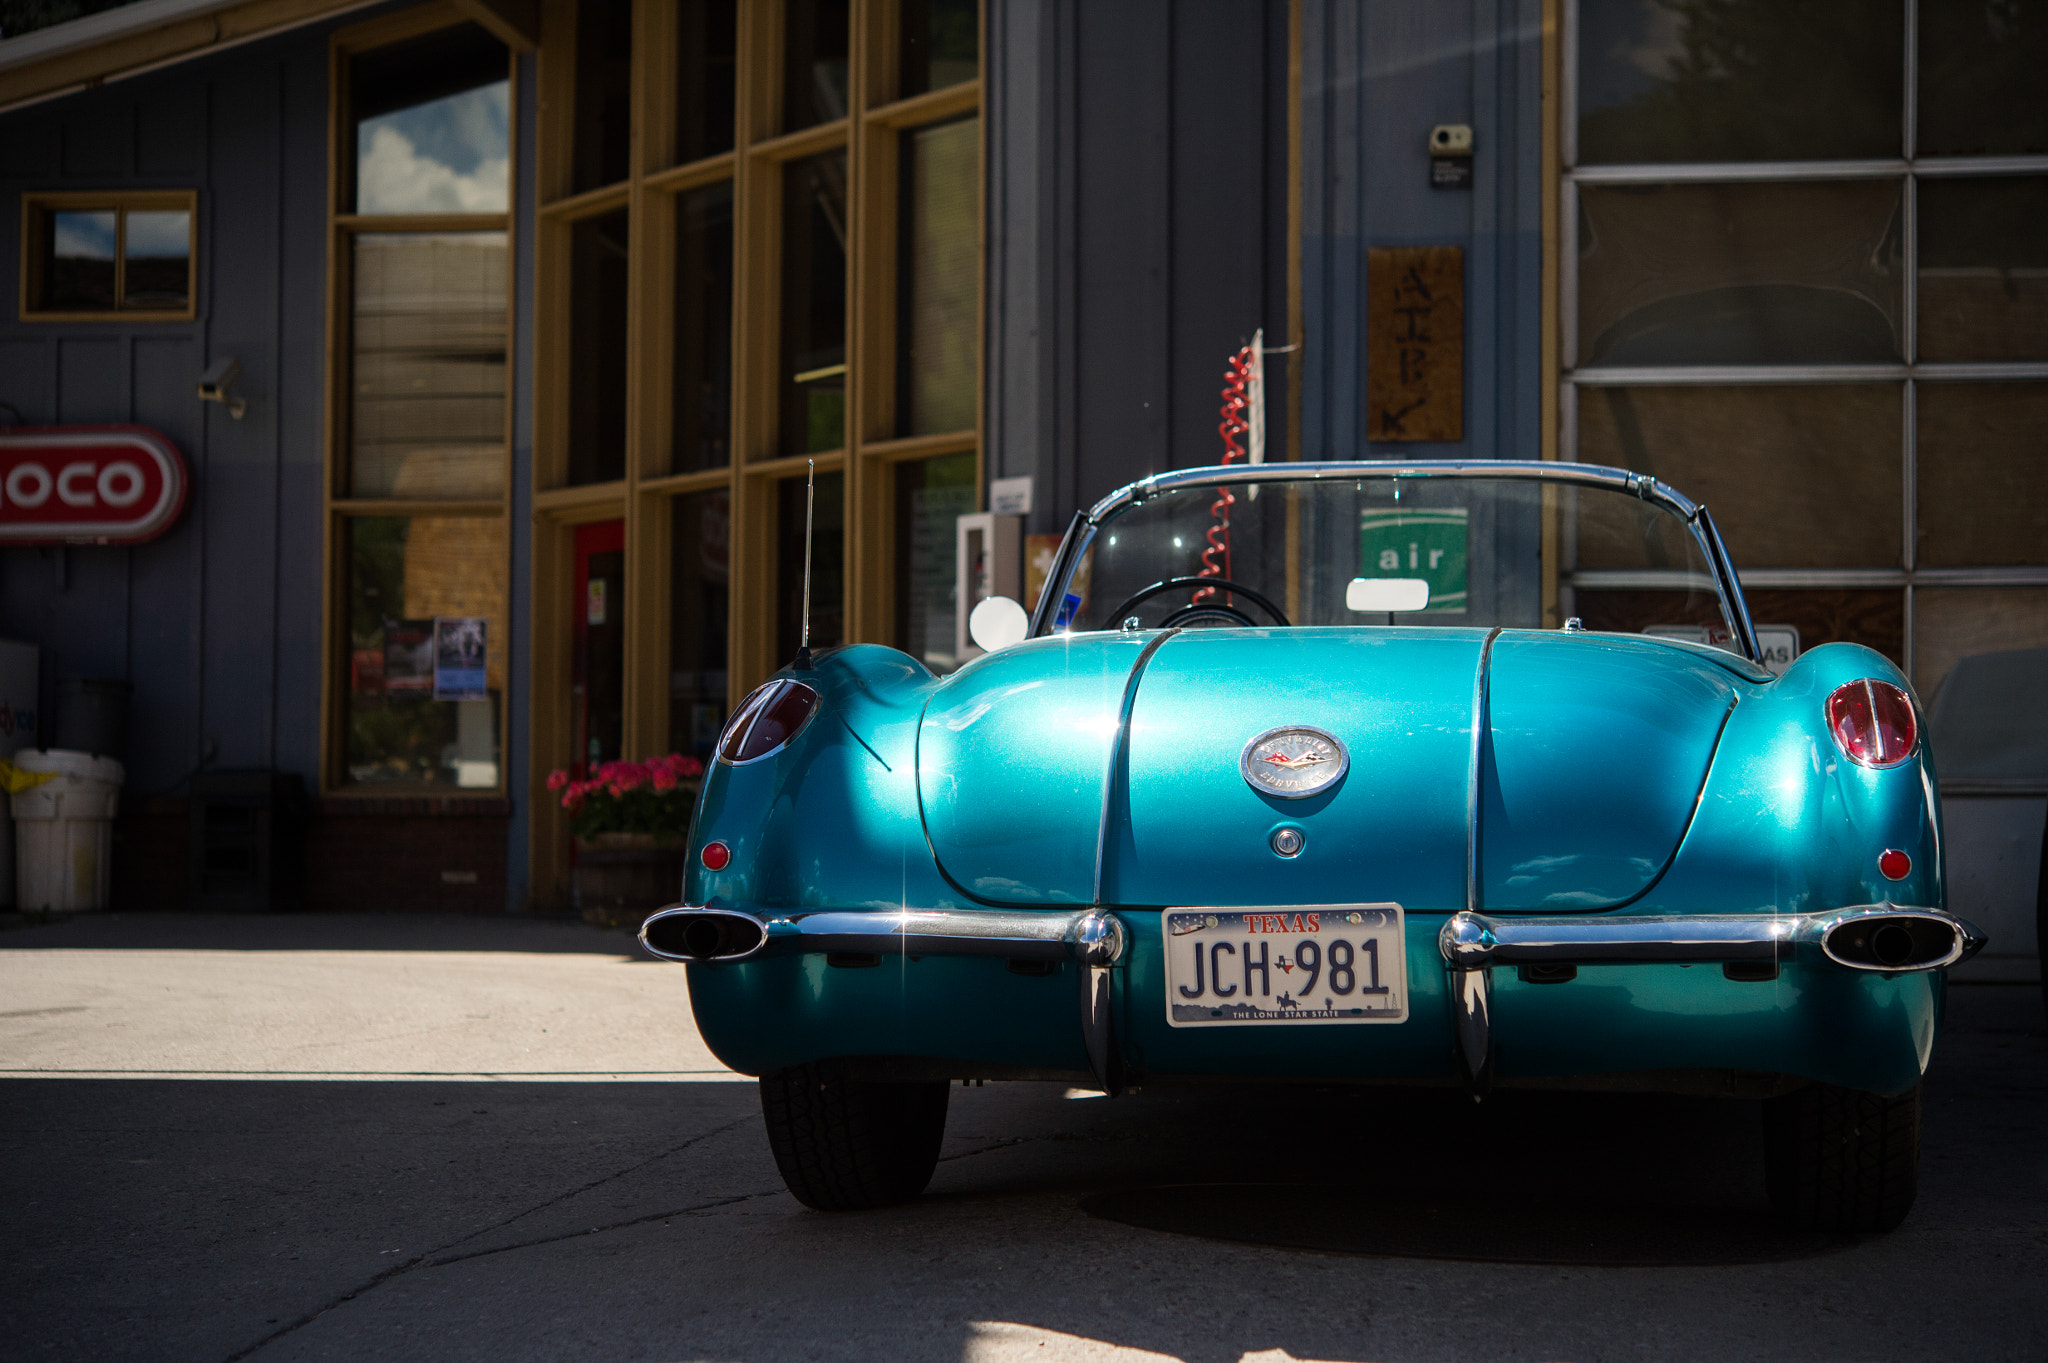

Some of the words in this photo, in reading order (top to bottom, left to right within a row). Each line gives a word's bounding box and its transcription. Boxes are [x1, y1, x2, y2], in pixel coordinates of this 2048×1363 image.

[1379, 542, 1444, 570] air
[1243, 914, 1320, 934] TEXAS
[1179, 941, 1270, 998] JCH
[1295, 938, 1389, 997] 981
[1254, 1011, 1279, 1019] LONE
[1285, 1010, 1308, 1018] STAR
[1312, 1010, 1339, 1018] STATE
